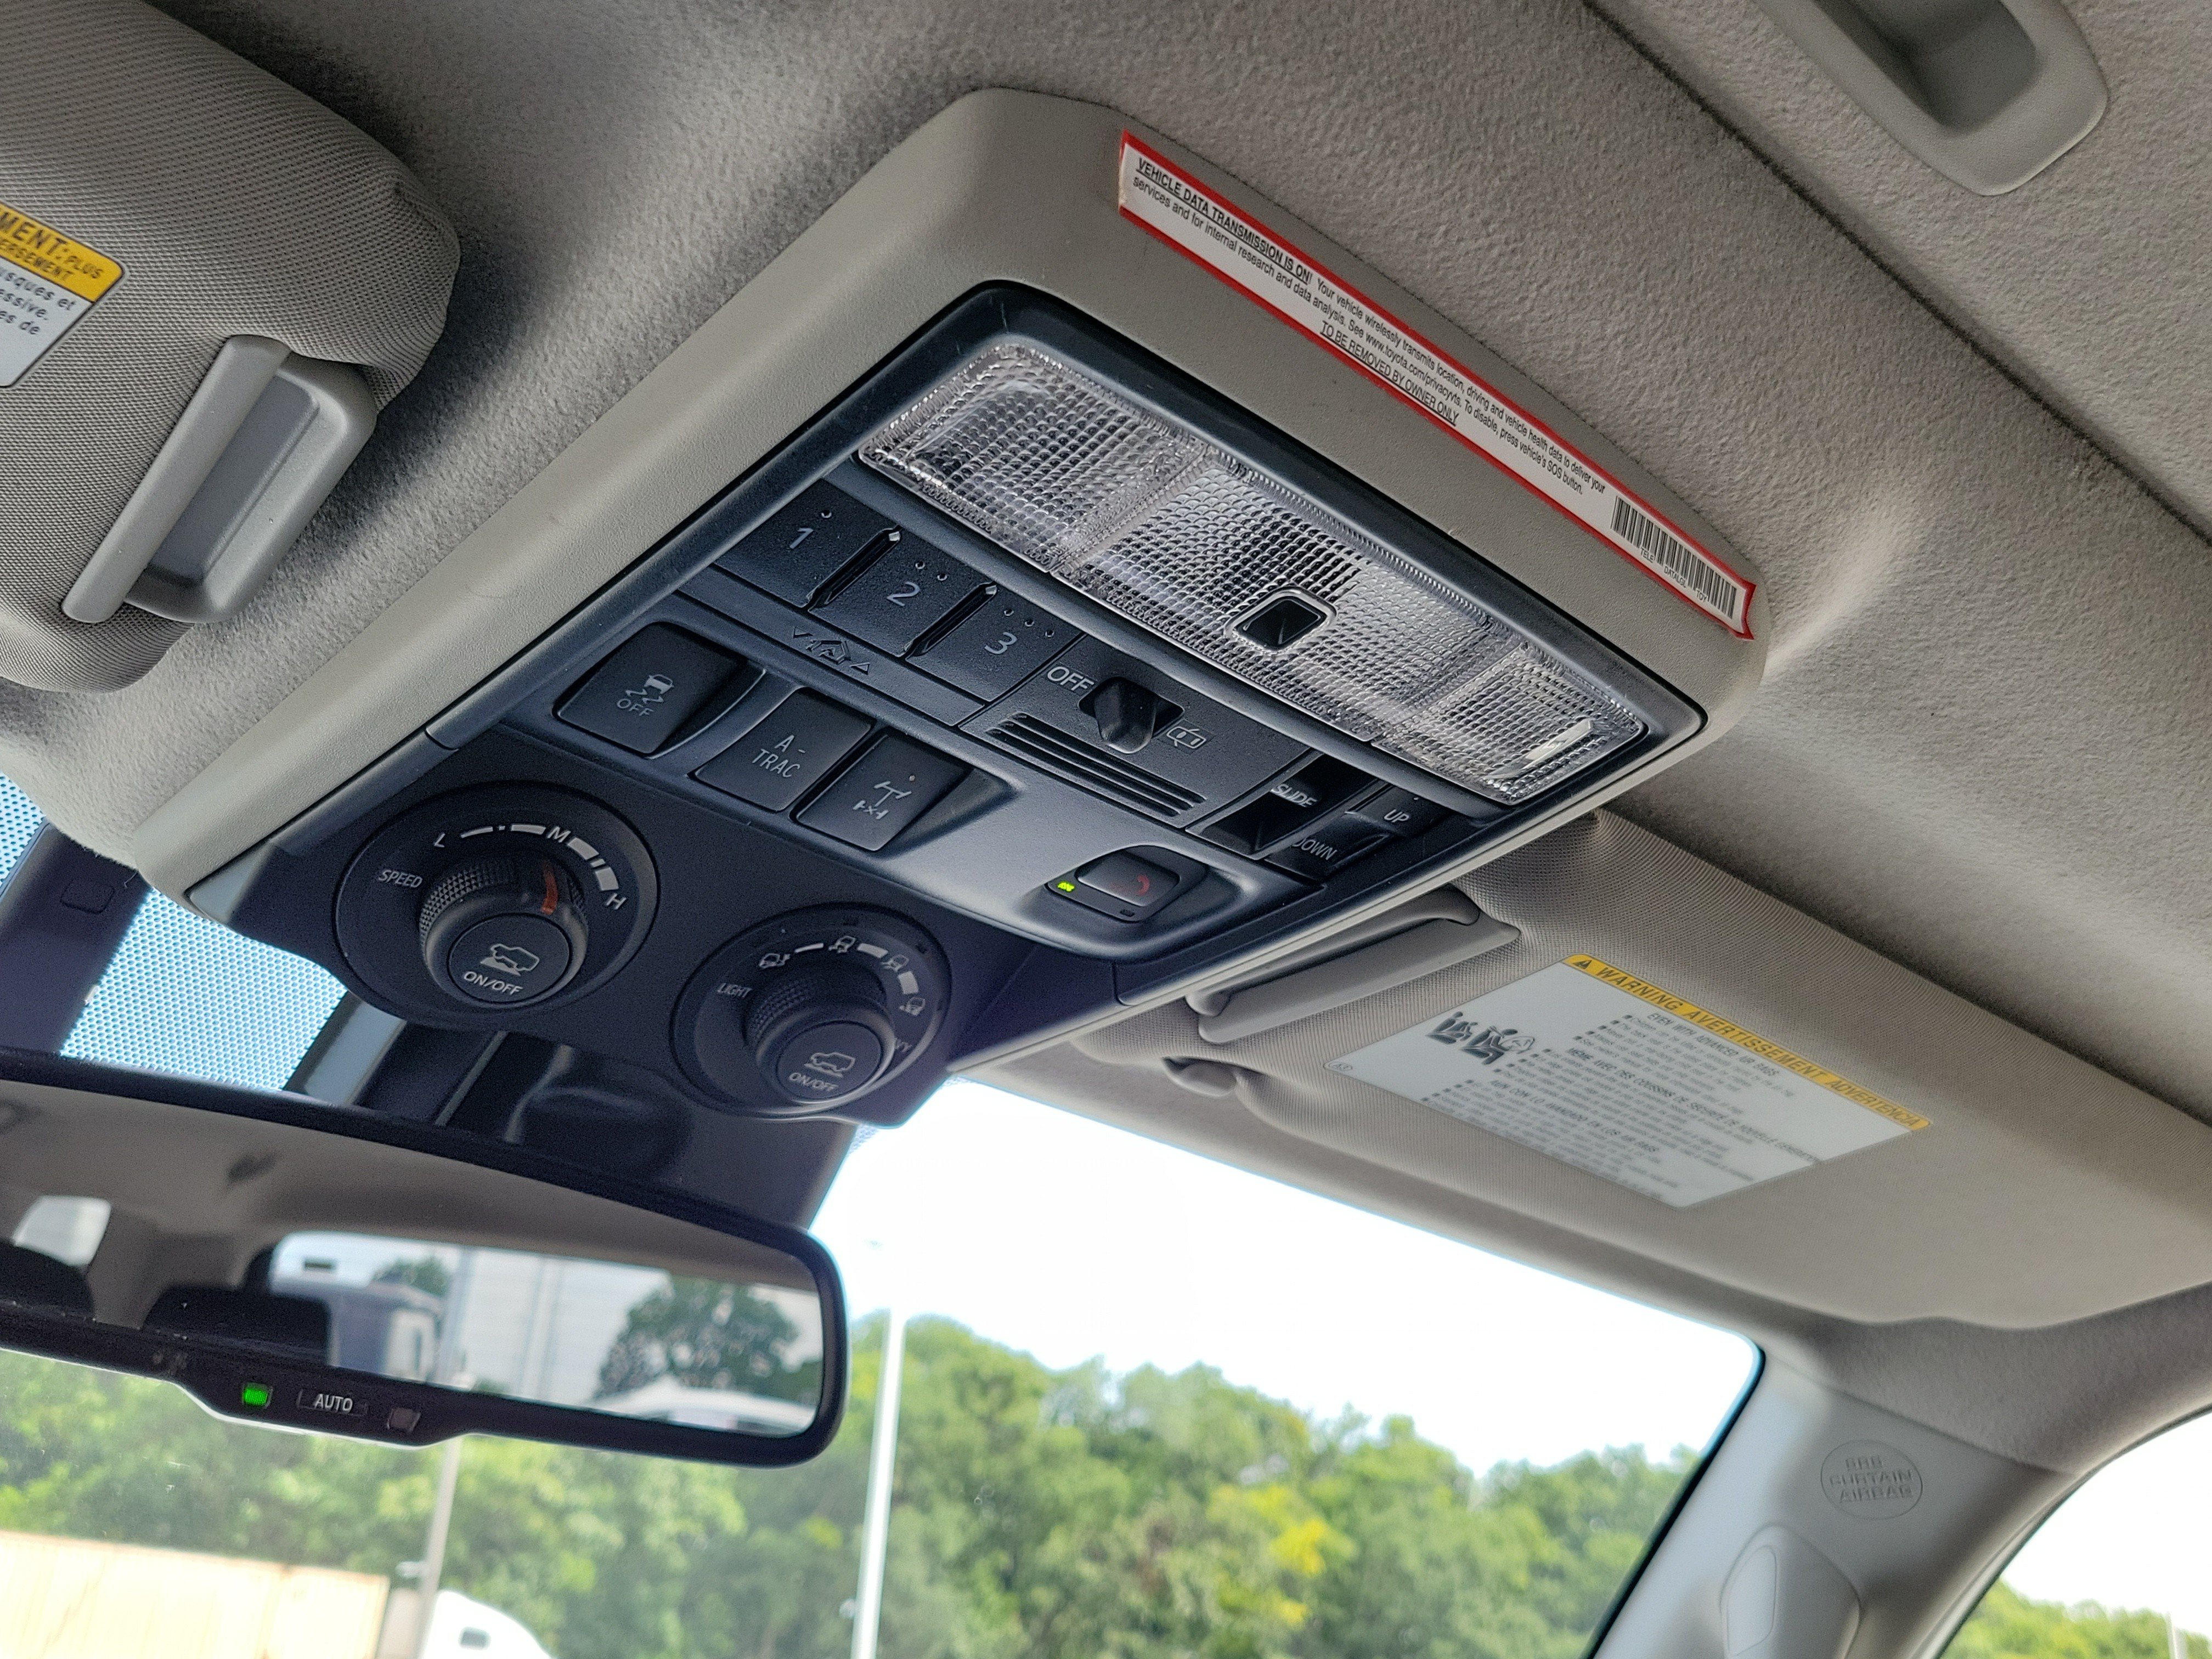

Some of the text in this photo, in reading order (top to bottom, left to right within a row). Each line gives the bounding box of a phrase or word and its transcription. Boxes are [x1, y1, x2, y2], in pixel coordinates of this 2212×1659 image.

[64, 255, 104, 279] PLUS
[57, 298, 76, 311] et
[19, 321, 40, 335] de
[1132, 177, 1583, 495] services and for internal research and data analysis. See www.toyota.com/privacyvts. To disable, press vehicle's SOS button.
[1138, 157, 1606, 494] VEHICLE DATA TRANSMISSION IS ON! Your vehicle wirelessly transmits location, driving and vehicle health data to deliver your
[1320, 320, 1460, 425] TO BE REMOVED BY OWNER ONLY
[789, 527, 815, 549] 1
[886, 580, 921, 607] 2
[985, 630, 1018, 655] 3
[1046, 665, 1095, 692] OFF
[617, 698, 653, 718] OFF
[752, 749, 801, 778] TRAC
[1271, 783, 1318, 808] SLIDE
[1383, 808, 1410, 823] UP
[546, 825, 571, 843] M
[378, 868, 422, 889] SPEED
[606, 892, 628, 911] H
[463, 970, 523, 997] ON/OFF
[716, 982, 753, 999] LIGHT
[1645, 1013, 1674, 1026] EVEN
[1595, 967, 1684, 1011] WARNING
[1683, 1009, 1829, 1080] AVERTISSEMENT
[1824, 1080, 1921, 1127] ADVERTENCIA
[788, 1071, 839, 1093] ON/OFF
[314, 1392, 354, 1414] AUTO
